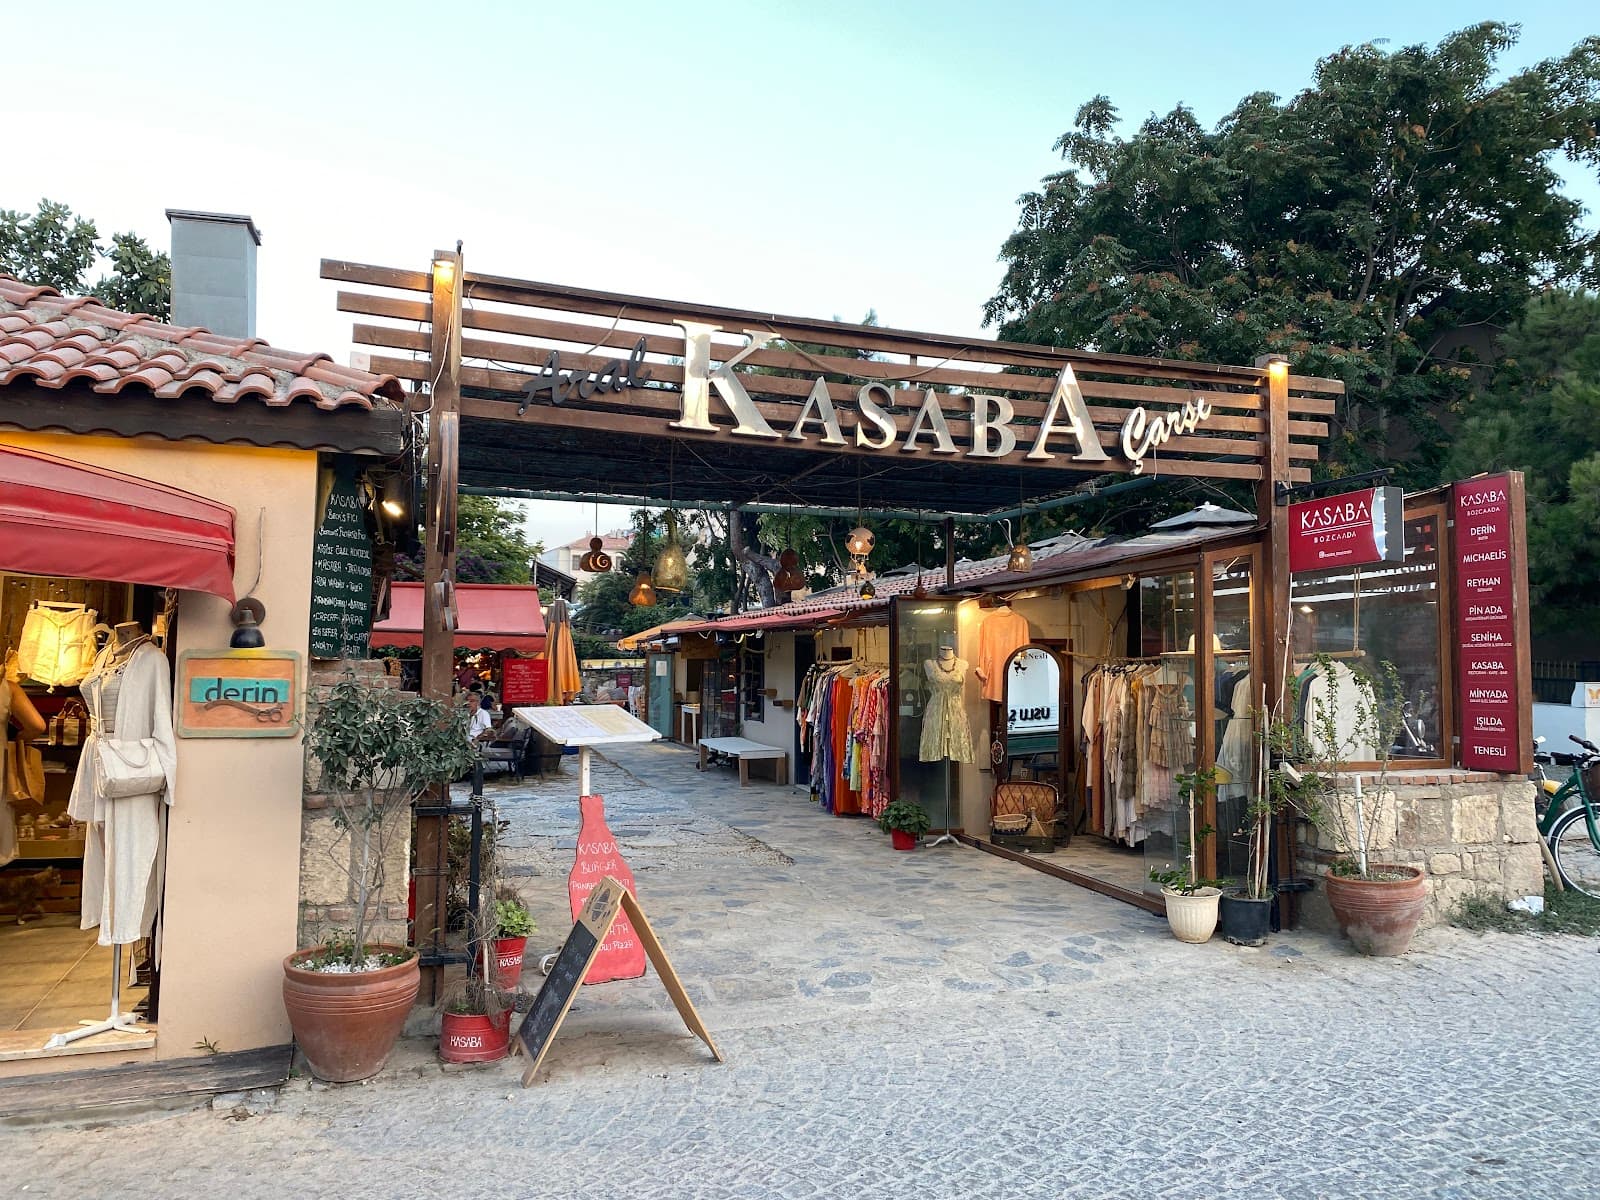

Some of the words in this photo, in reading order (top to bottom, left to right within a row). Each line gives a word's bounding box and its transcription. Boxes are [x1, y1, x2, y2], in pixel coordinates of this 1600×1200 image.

[668, 318, 1112, 461] KASABA
[1460, 489, 1506, 507] KASABA
[1301, 500, 1370, 530] KASABA
[1466, 506, 1501, 517] BOZCAADA
[1470, 523, 1496, 536] DERİN
[1313, 530, 1357, 544] BOZCAADA
[1466, 577, 1501, 588] REYHAN
[1469, 605, 1483, 615] PİN
[1484, 605, 1503, 615] ADA
[1471, 631, 1503, 642] SENİHA
[1471, 661, 1504, 670] KASABA
[204, 677, 279, 703] derin
[1469, 688, 1508, 699] MİNYADA
[1476, 716, 1503, 728] IŞILDA
[1473, 745, 1506, 757] TENESLİ
[578, 841, 618, 855] KASABA
[450, 1036, 482, 1048] KASABA
